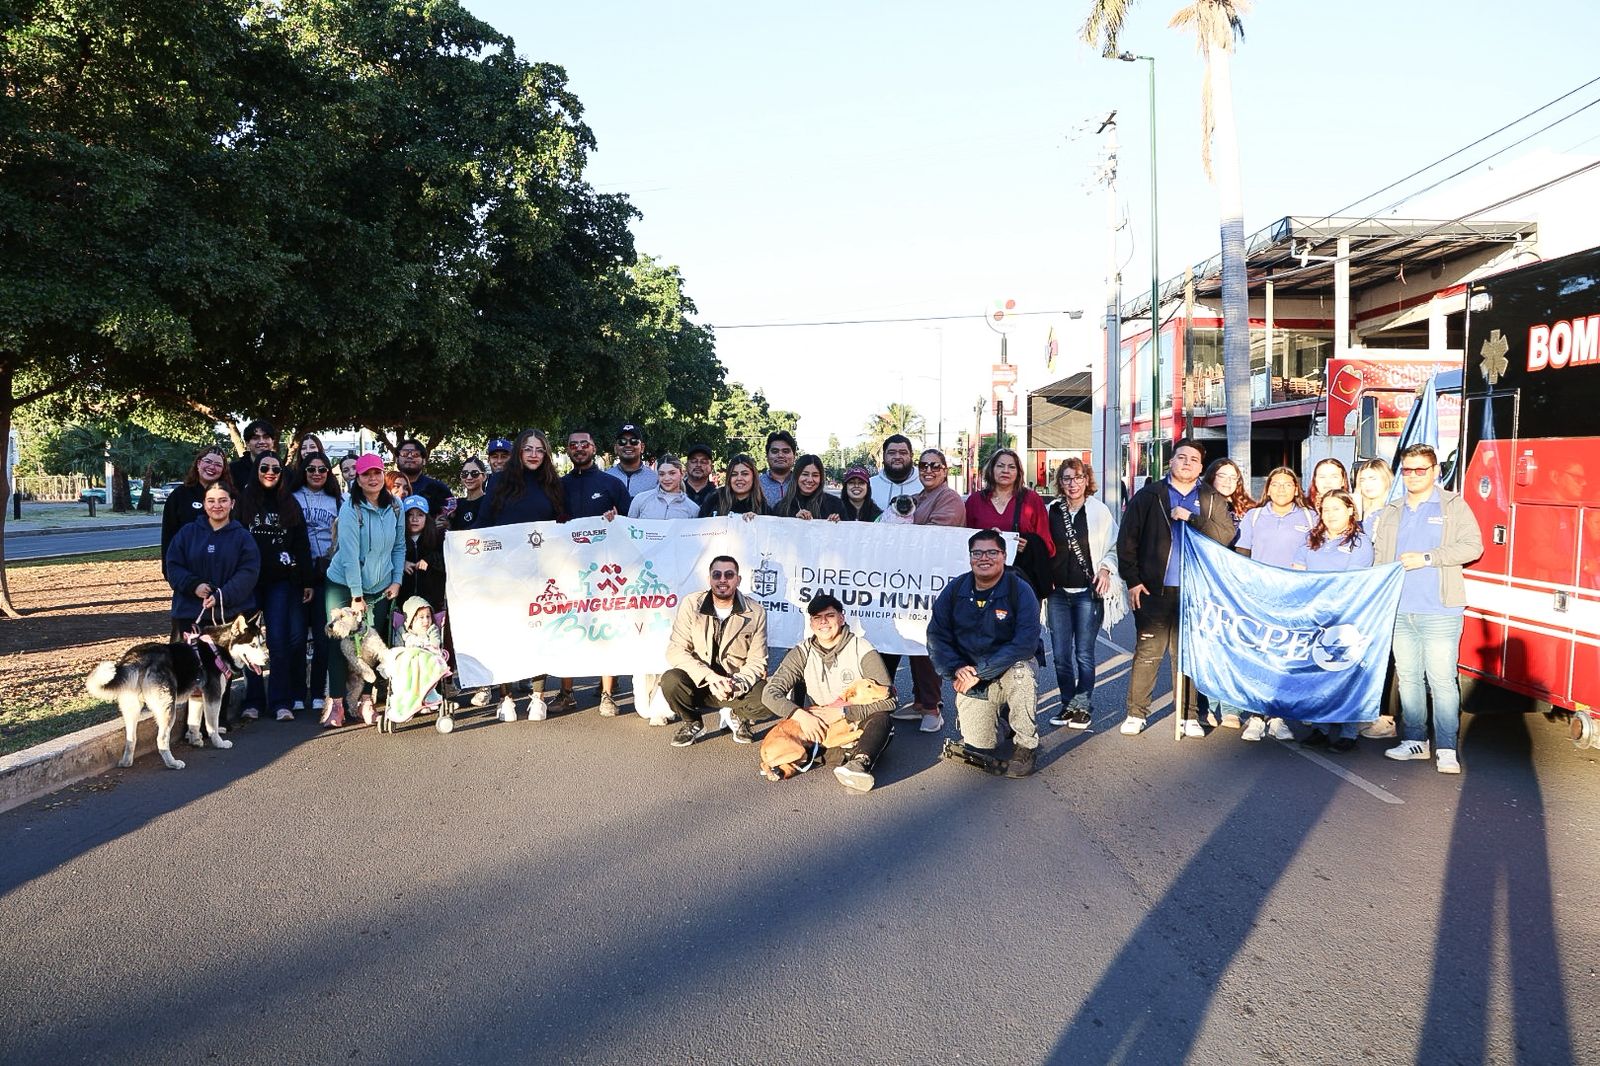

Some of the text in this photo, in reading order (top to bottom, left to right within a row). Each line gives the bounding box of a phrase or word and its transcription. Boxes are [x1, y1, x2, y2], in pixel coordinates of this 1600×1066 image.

[801, 567, 922, 590] DIRECCIÓN
[528, 594, 678, 616] DOMINGUEANDO
[850, 609, 903, 620] MUNICIPAL
